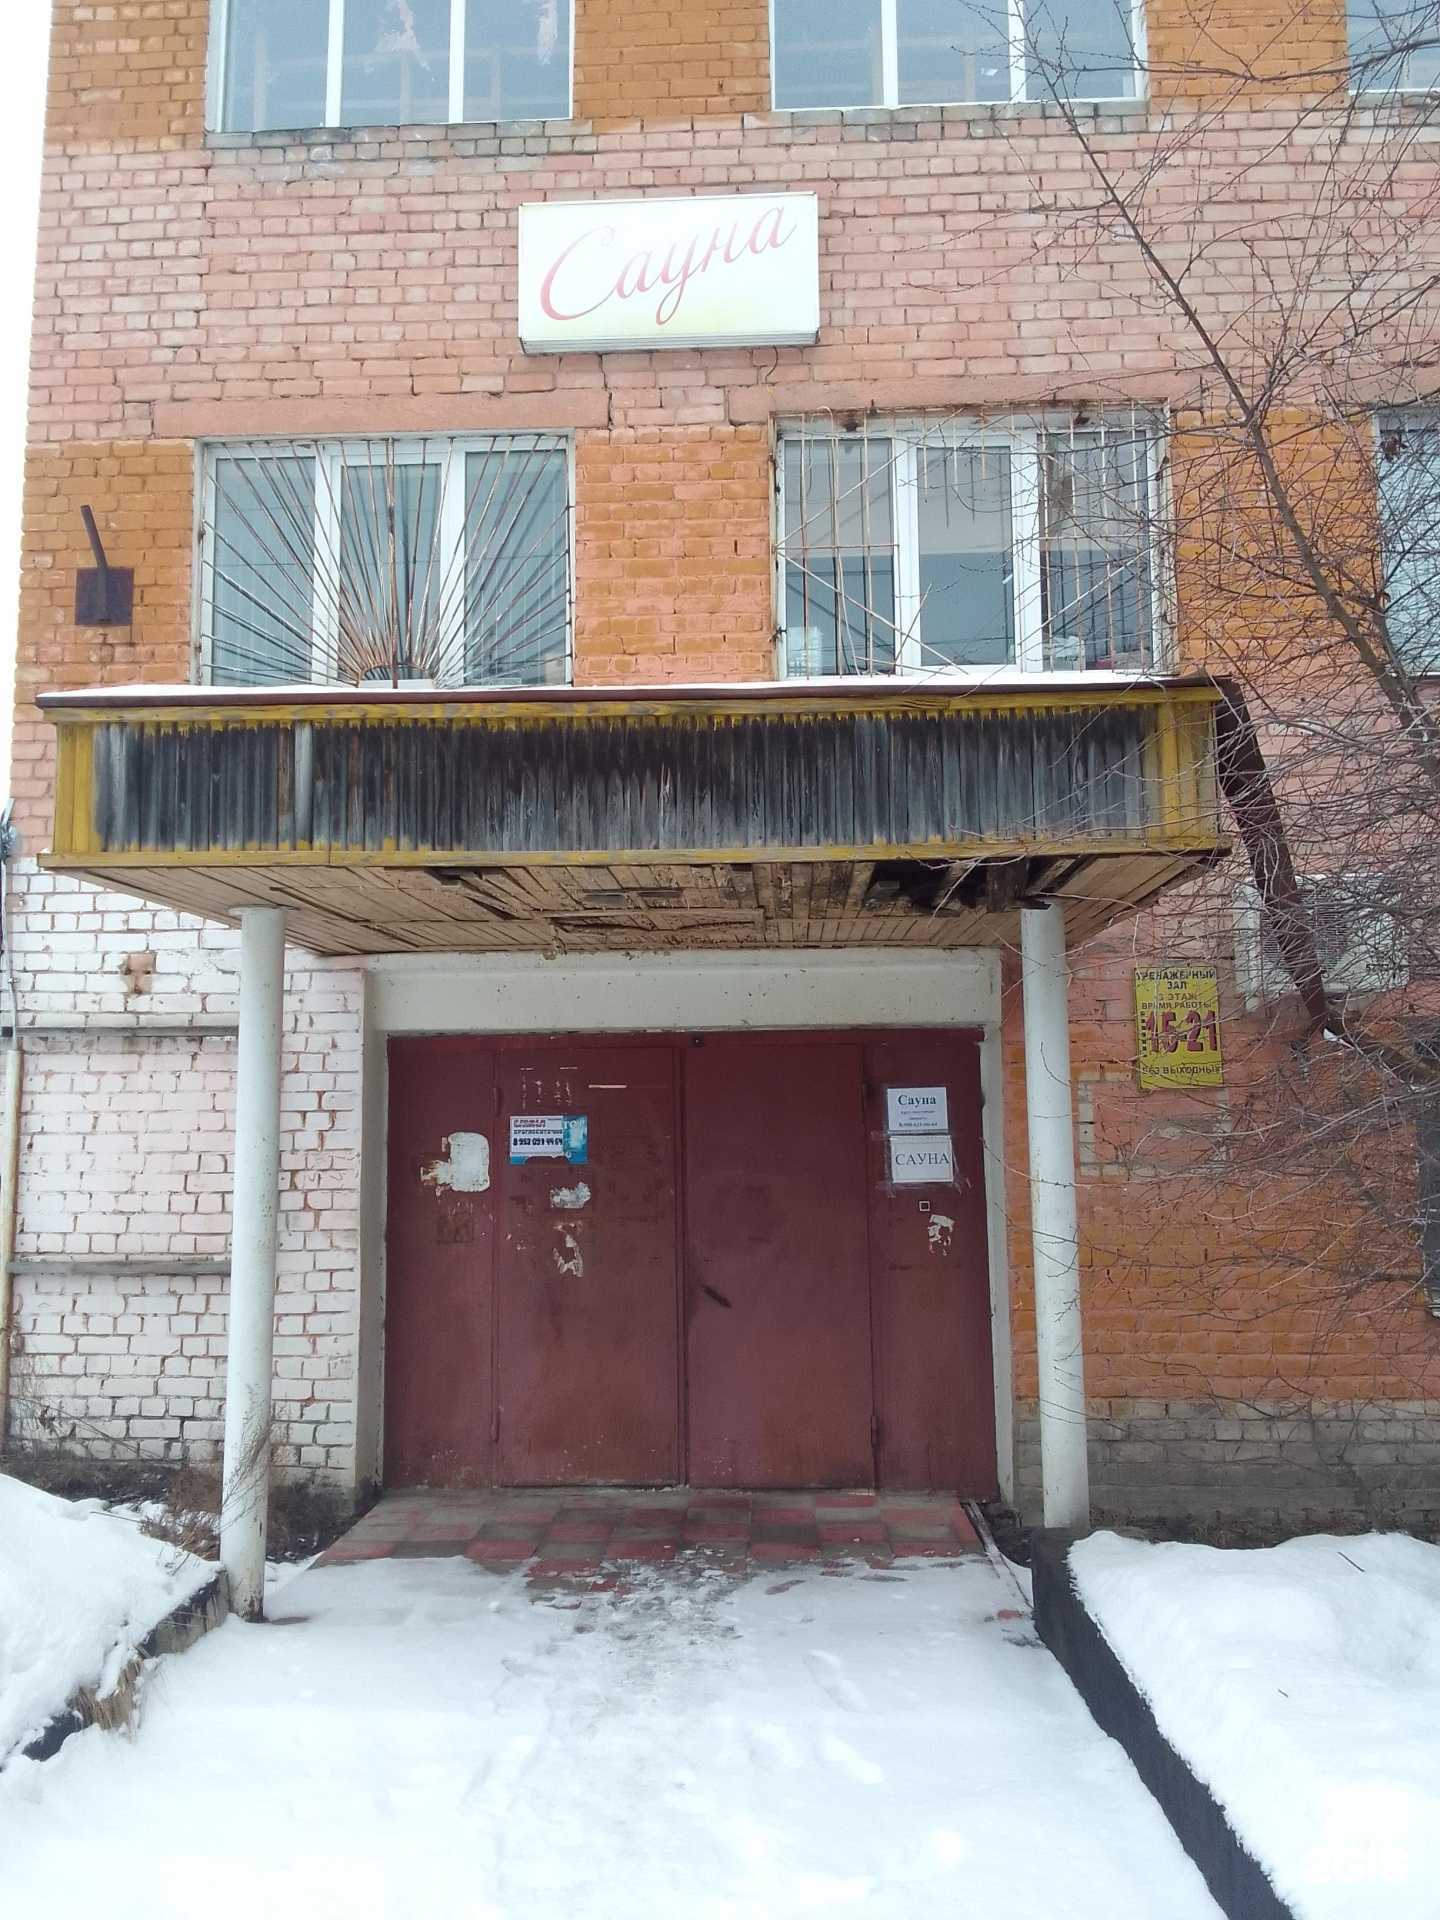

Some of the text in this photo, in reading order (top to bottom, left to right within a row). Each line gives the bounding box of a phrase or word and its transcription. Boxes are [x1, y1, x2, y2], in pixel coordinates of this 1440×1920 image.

[539, 205, 797, 326] Сауна
[1167, 981, 1187, 990] ЗАЛ
[1166, 992, 1199, 1001] ЭТАЖ
[1173, 1001, 1212, 1010] РАБОТЫ
[898, 1094, 937, 1108] Сауна
[895, 1152, 950, 1167] САУНА
